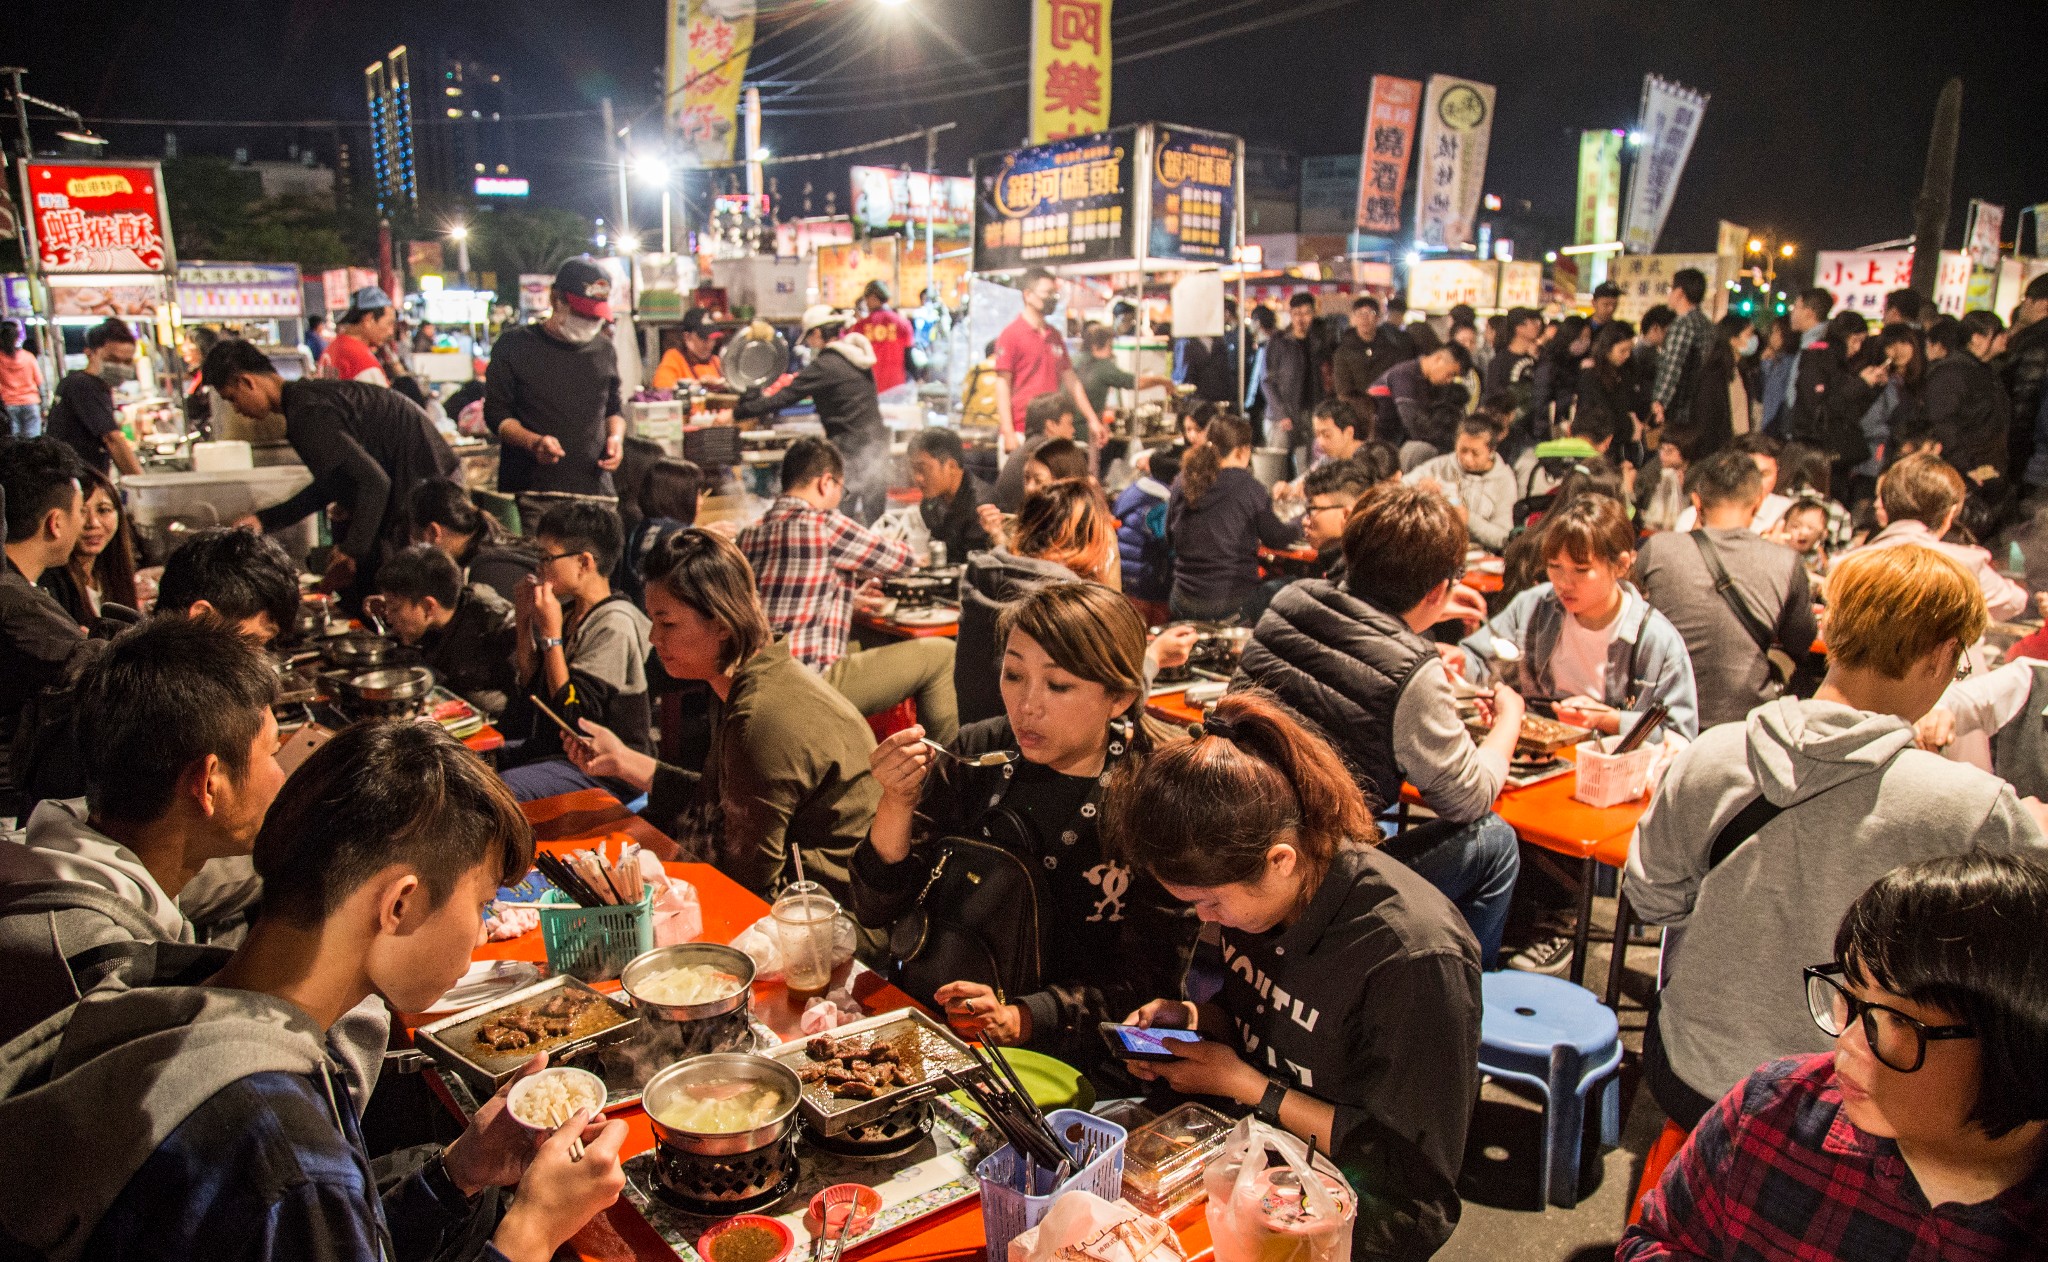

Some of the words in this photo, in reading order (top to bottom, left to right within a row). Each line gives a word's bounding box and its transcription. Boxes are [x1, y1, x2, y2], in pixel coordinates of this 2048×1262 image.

[1007, 158, 1121, 209] 銀河碼頭
[43, 210, 154, 250] 蝦猴酥
